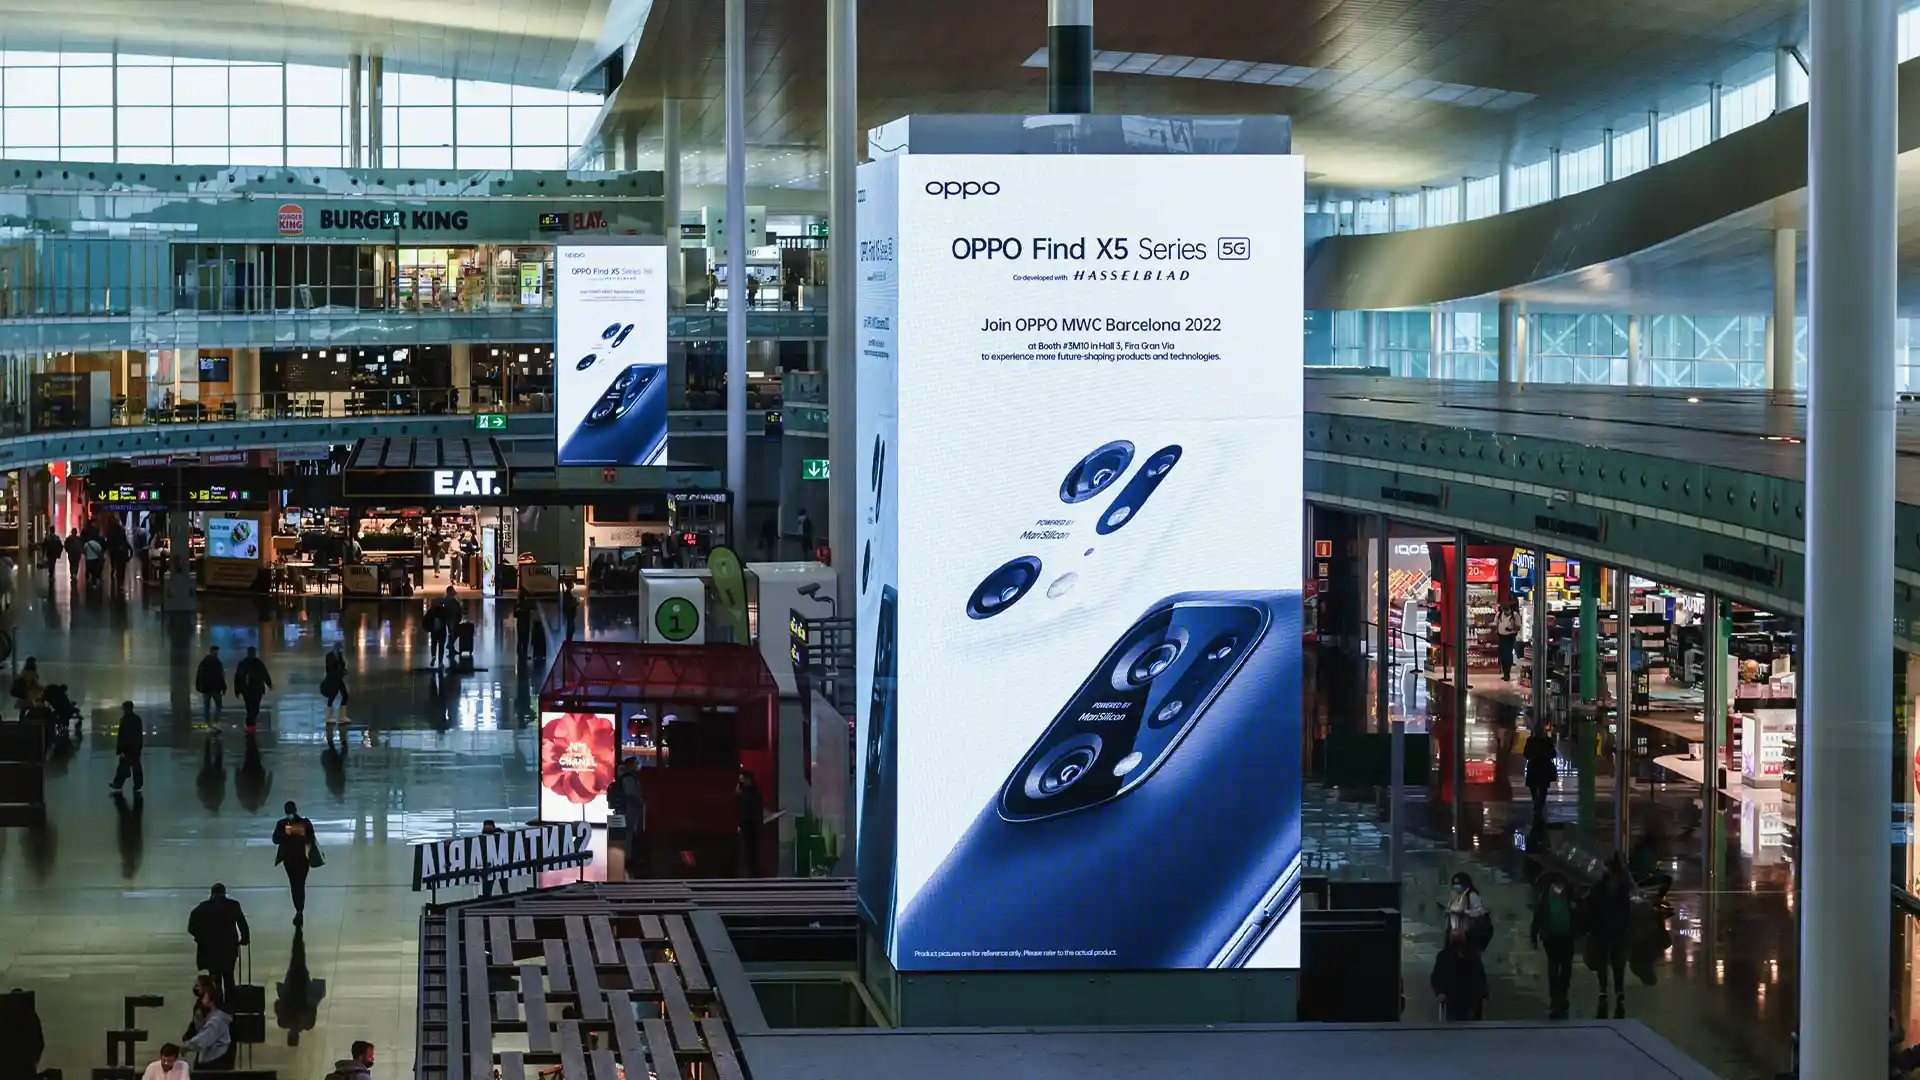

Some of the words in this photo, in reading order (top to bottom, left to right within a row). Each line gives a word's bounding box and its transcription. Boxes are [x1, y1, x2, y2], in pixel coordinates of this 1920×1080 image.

[925, 181, 1000, 200] oppo
[412, 210, 468, 230] KING
[952, 237, 1022, 260] OPPO
[1033, 237, 1085, 260] Find
[1096, 237, 1128, 260] X5
[1139, 237, 1207, 260] Series
[1221, 241, 1247, 256] 5G
[571, 267, 592, 275] OPPO
[593, 267, 609, 275] Find
[611, 267, 620, 275] X5
[1073, 270, 1190, 281] HASSELBLAD
[981, 318, 1011, 331] Join
[1016, 318, 1057, 332] OPPO
[1062, 318, 1102, 332] MWC
[1106, 318, 1180, 332] Barcelona
[1185, 318, 1221, 332] 2022
[1038, 342, 1062, 350] Booth
[1063, 342, 1089, 350] #3M10
[1090, 342, 1098, 350] in
[1099, 342, 1115, 350] Hall
[1125, 342, 1140, 350] Fira
[1141, 342, 1160, 350] Gran
[1161, 342, 1175, 350] Via
[981, 353, 990, 361] to
[991, 352, 1034, 362] experience
[1058, 352, 1115, 362] future-shaping
[1117, 352, 1152, 361] products
[1152, 352, 1169, 361] and
[1170, 352, 1222, 362] technologies.
[433, 470, 501, 496] EAT.
[1020, 530, 1070, 540] MariSilicon
[1394, 544, 1429, 556] IQOS
[1078, 712, 1126, 722] MariSilicon
[938, 950, 961, 958] pictures
